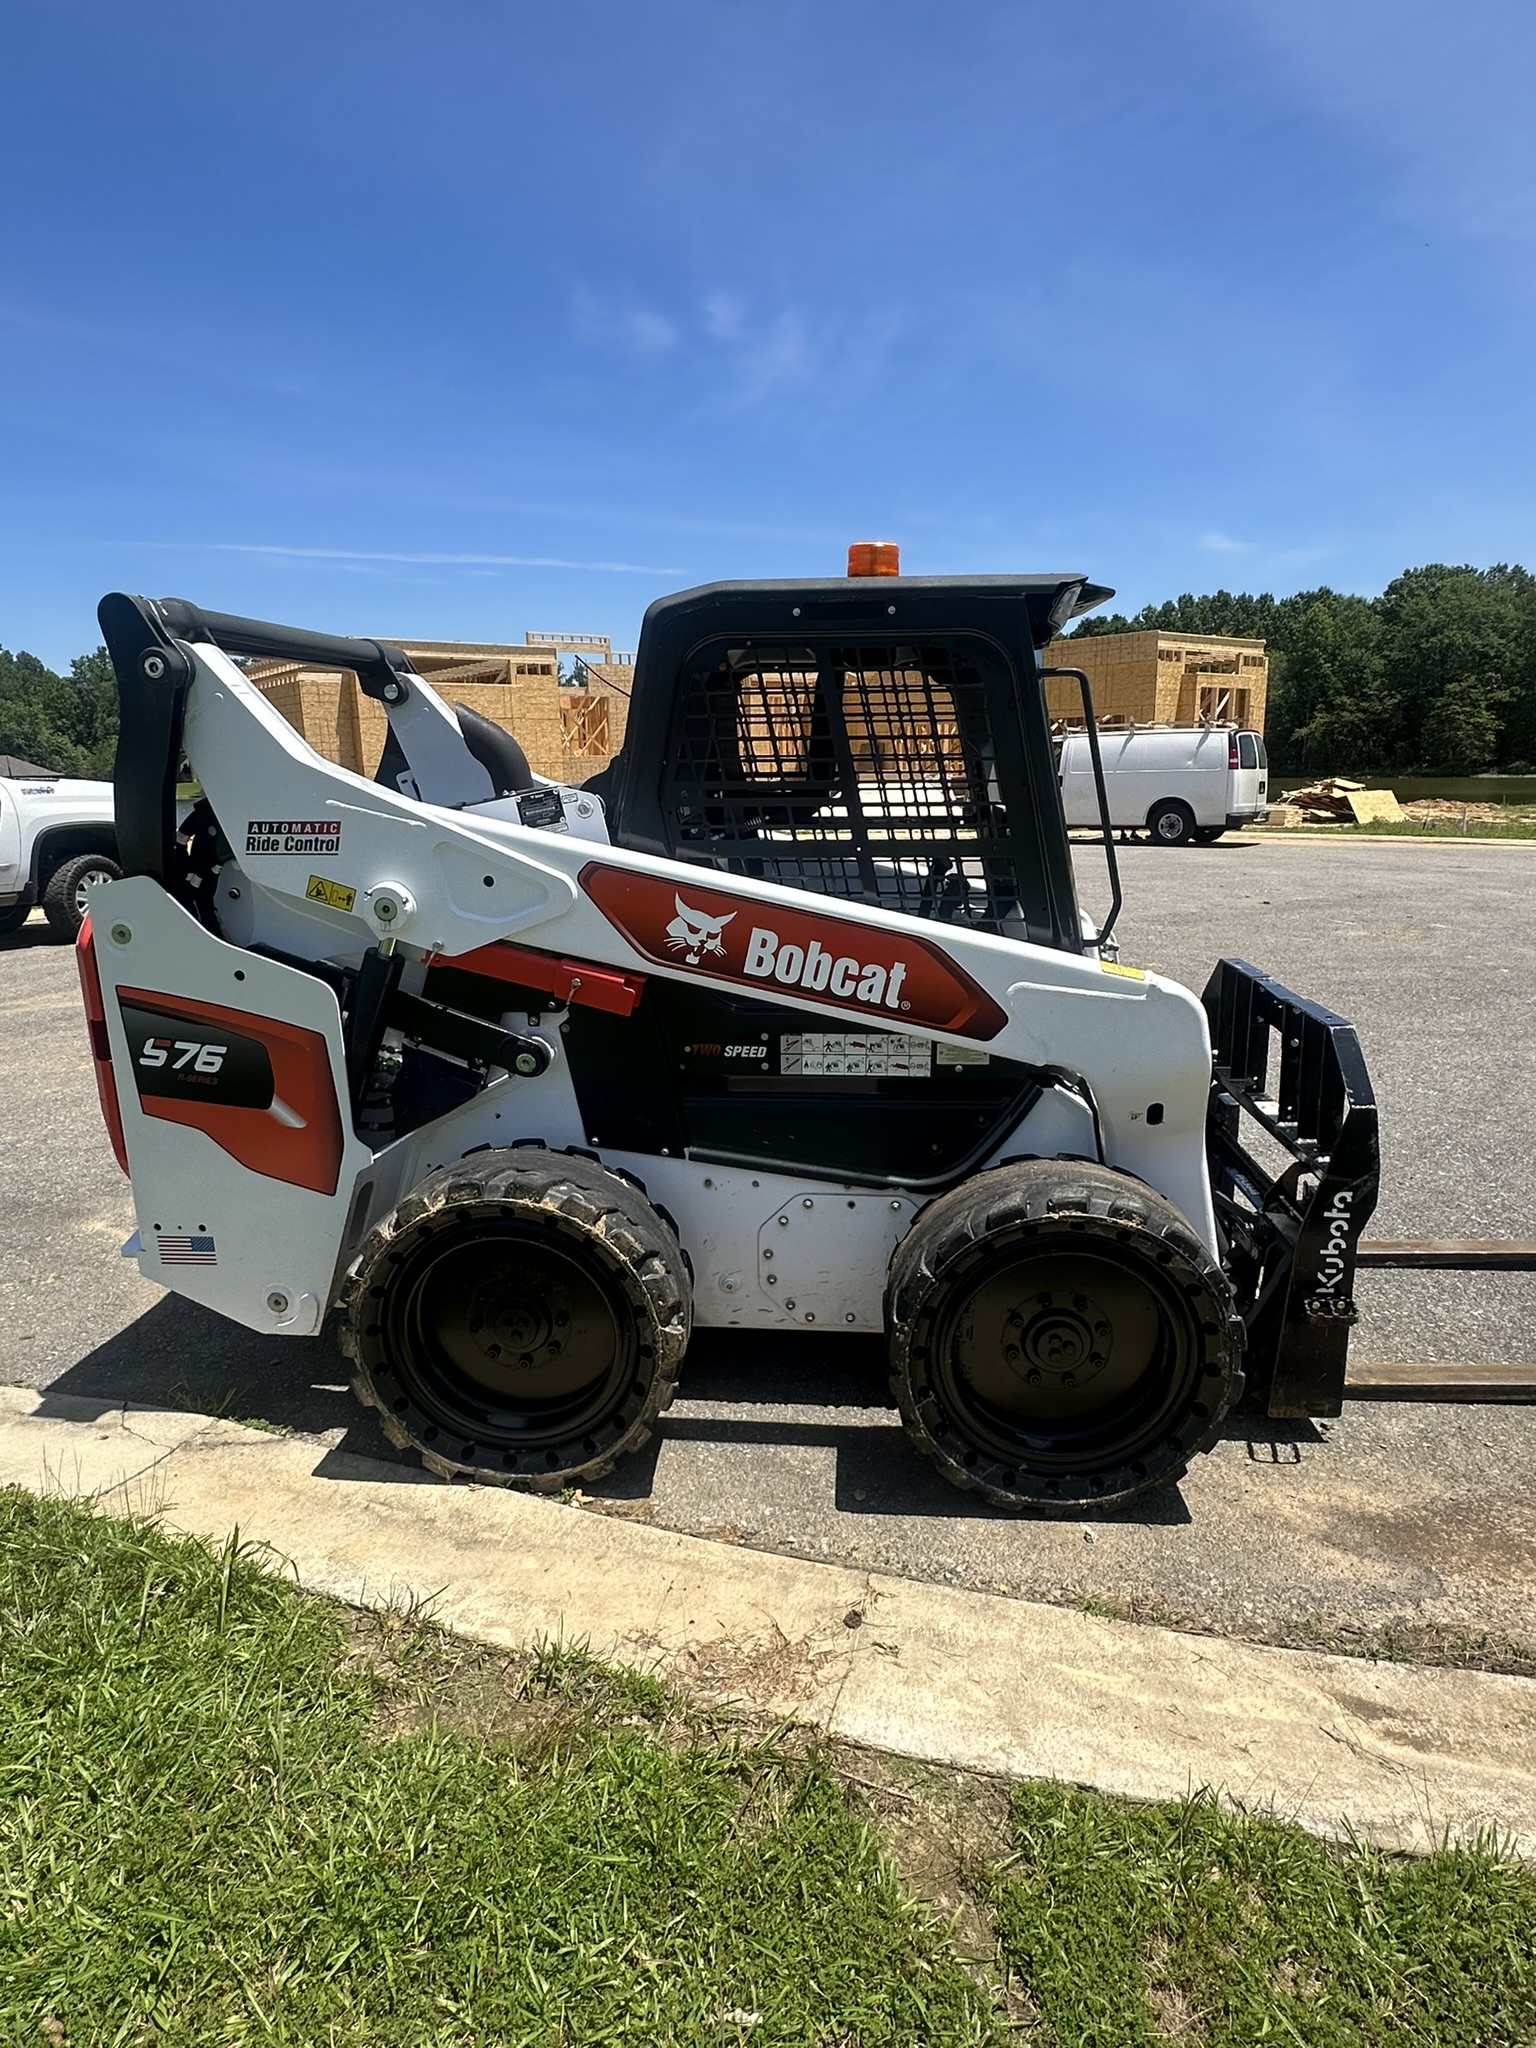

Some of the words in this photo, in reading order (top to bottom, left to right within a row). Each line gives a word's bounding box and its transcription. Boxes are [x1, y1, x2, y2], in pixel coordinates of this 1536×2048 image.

[250, 823, 338, 834] AUTOMATIC
[245, 836, 280, 852] Ride
[284, 836, 340, 852] Control
[743, 926, 907, 1009] Bobcat
[139, 1038, 228, 1073] S76
[692, 1043, 721, 1056] TWO
[723, 1045, 768, 1058] SPEED
[177, 1073, 219, 1086] R-SERIES
[1315, 1191, 1354, 1294] Kubota
